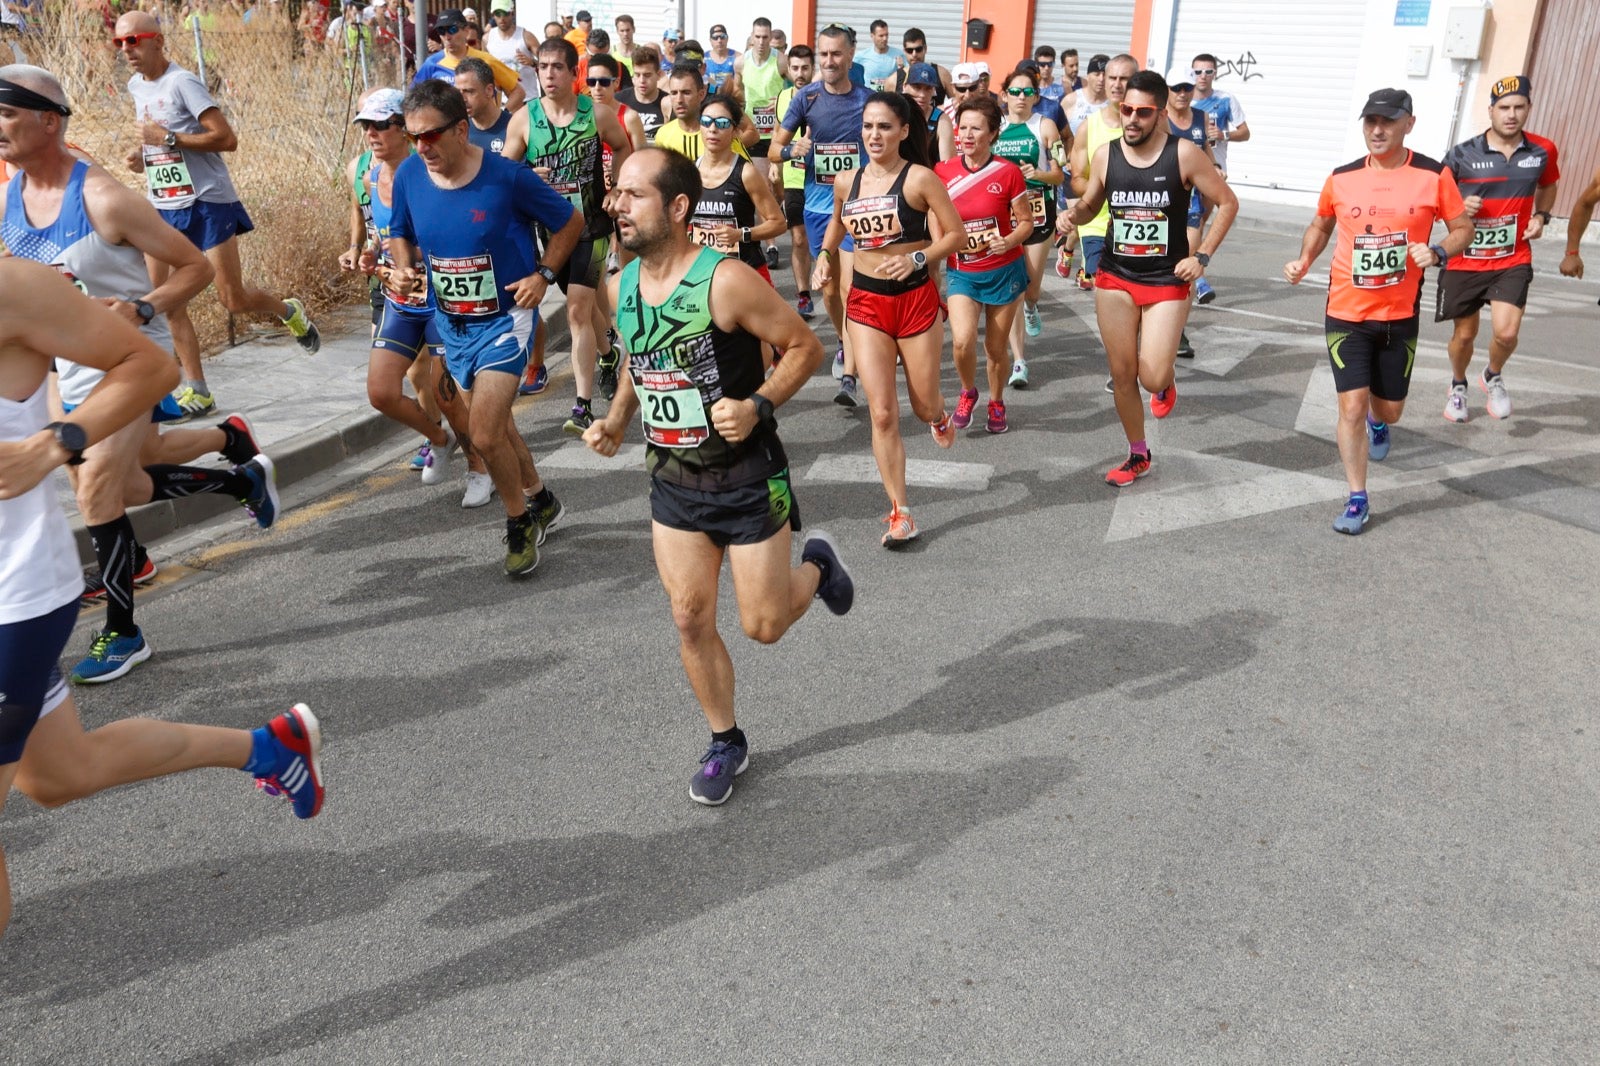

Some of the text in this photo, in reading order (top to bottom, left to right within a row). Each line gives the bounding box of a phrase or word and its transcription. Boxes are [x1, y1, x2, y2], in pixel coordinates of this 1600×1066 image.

[823, 156, 853, 172] 109
[155, 165, 183, 185] 496
[1111, 190, 1170, 203] GRANADA
[850, 213, 894, 235] 2037
[1122, 222, 1159, 241] 732
[1474, 228, 1508, 245] 923
[1361, 249, 1399, 271] 546
[440, 275, 484, 297] 257
[647, 394, 680, 423] 20
